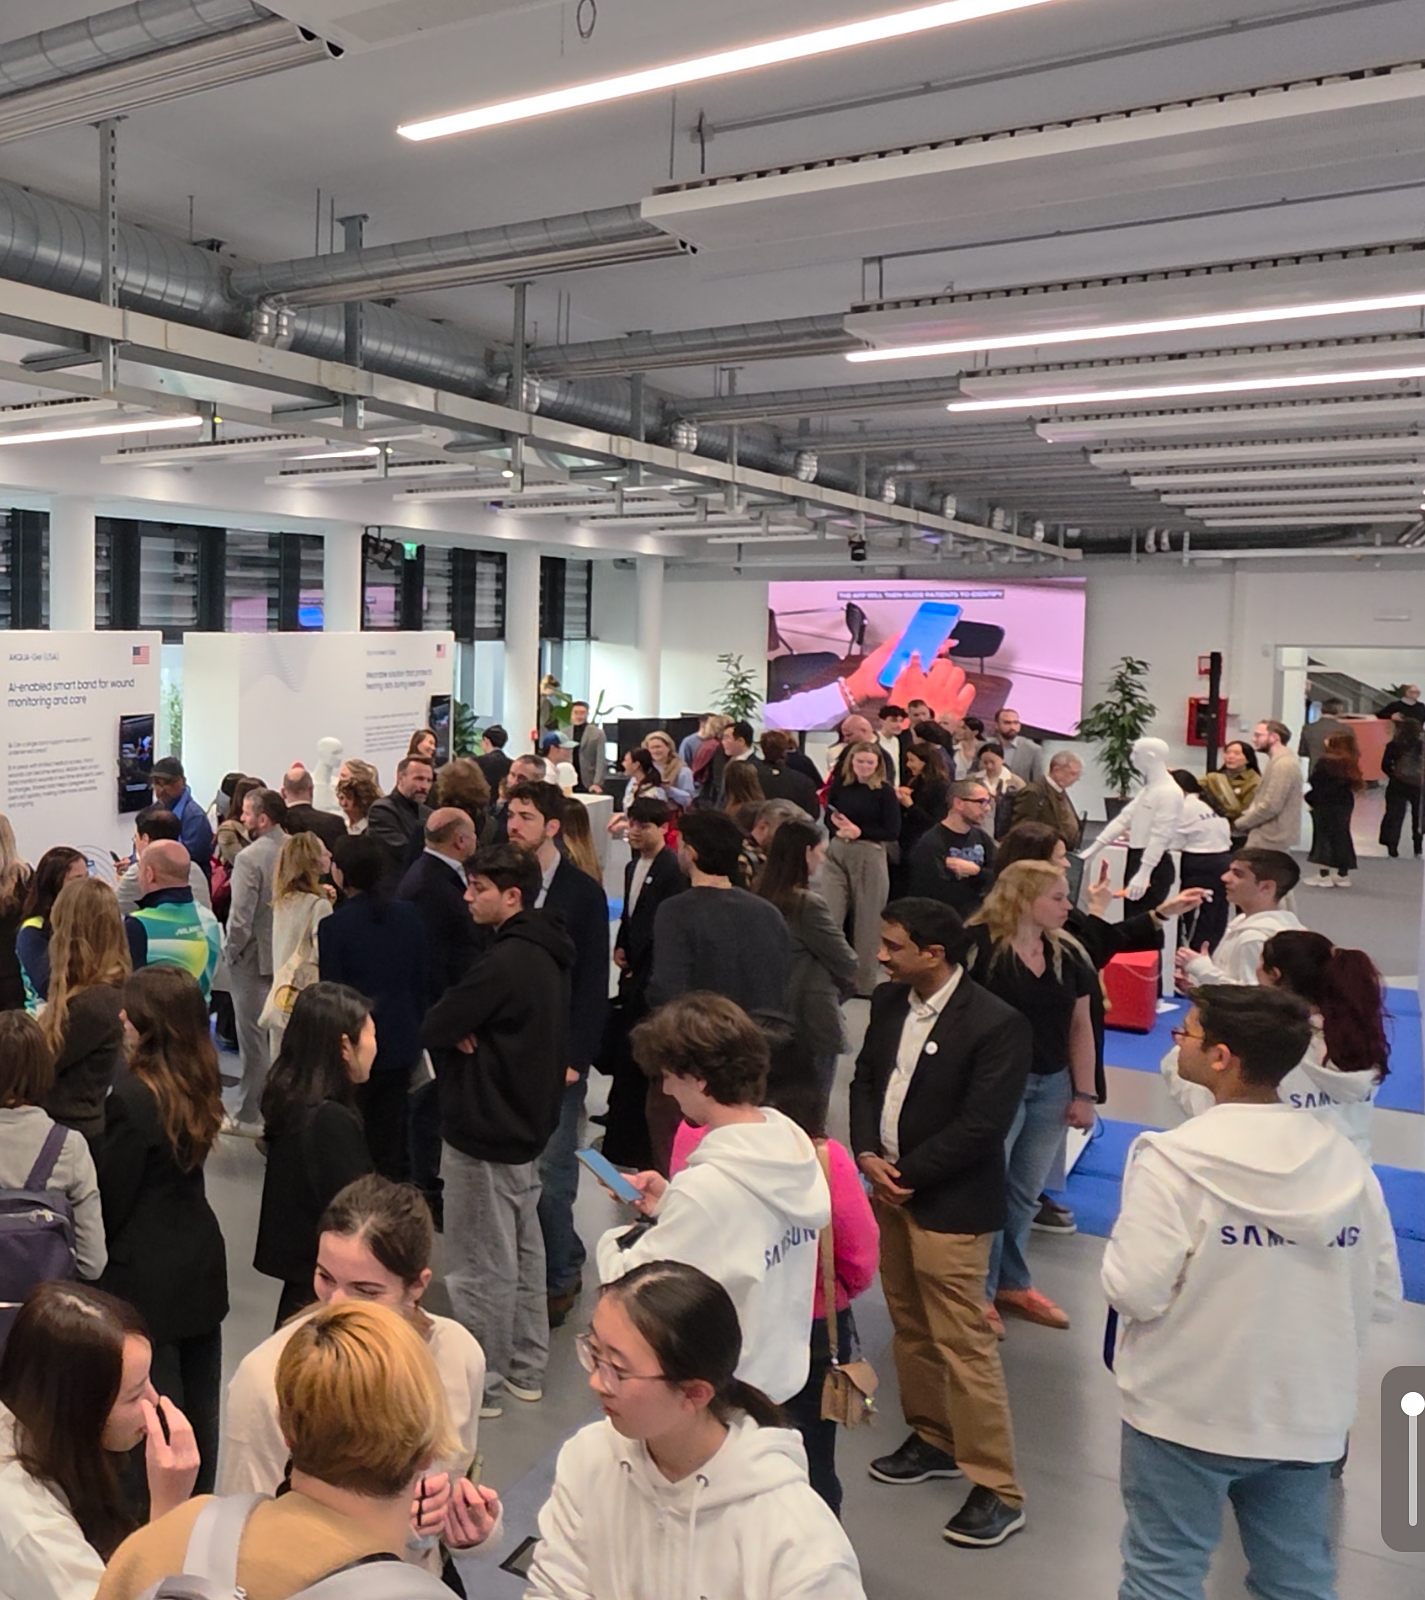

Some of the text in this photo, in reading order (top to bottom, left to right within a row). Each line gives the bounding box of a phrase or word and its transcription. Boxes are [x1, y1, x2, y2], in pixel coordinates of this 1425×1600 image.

[8, 678, 135, 692] AI-enabled smart band for wound
[8, 696, 87, 709] monitoring and care
